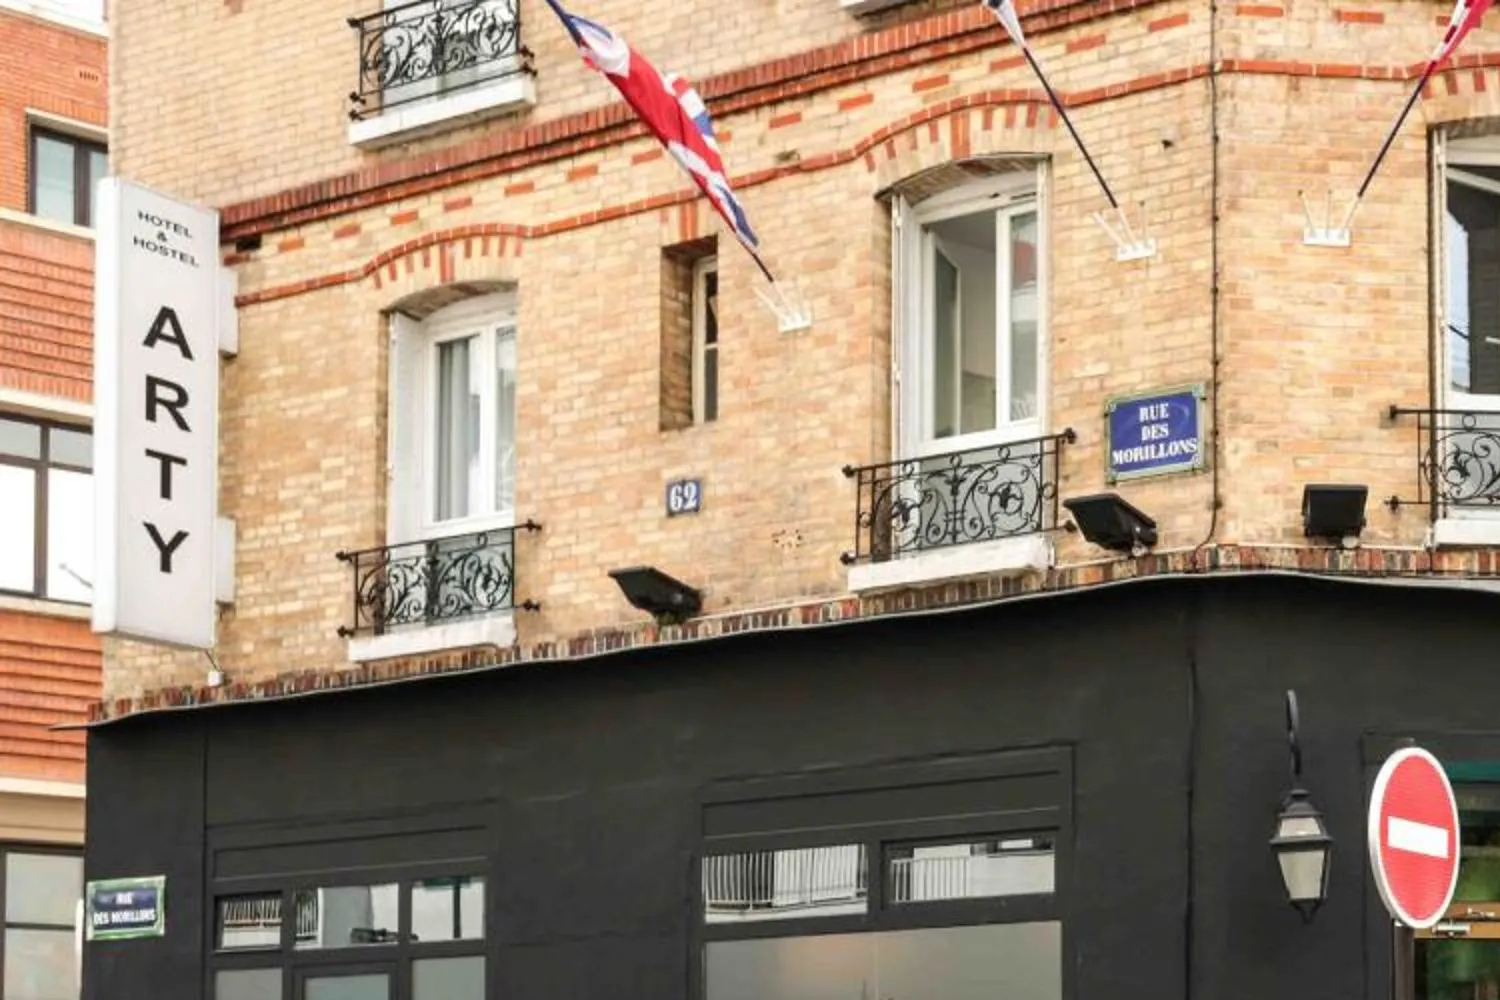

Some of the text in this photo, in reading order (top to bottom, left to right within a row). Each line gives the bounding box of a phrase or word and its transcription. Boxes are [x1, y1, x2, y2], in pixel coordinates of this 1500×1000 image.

[138, 209, 193, 239] HOTEL
[156, 231, 167, 242] &
[133, 234, 200, 269] HOSTEL
[1139, 402, 1169, 422] RUE
[142, 305, 194, 575] ARTY
[1141, 422, 1169, 441] DES
[1112, 437, 1197, 466] MORILLONS
[670, 482, 698, 511] 62
[115, 891, 133, 905] RUE
[93, 911, 109, 925] DES
